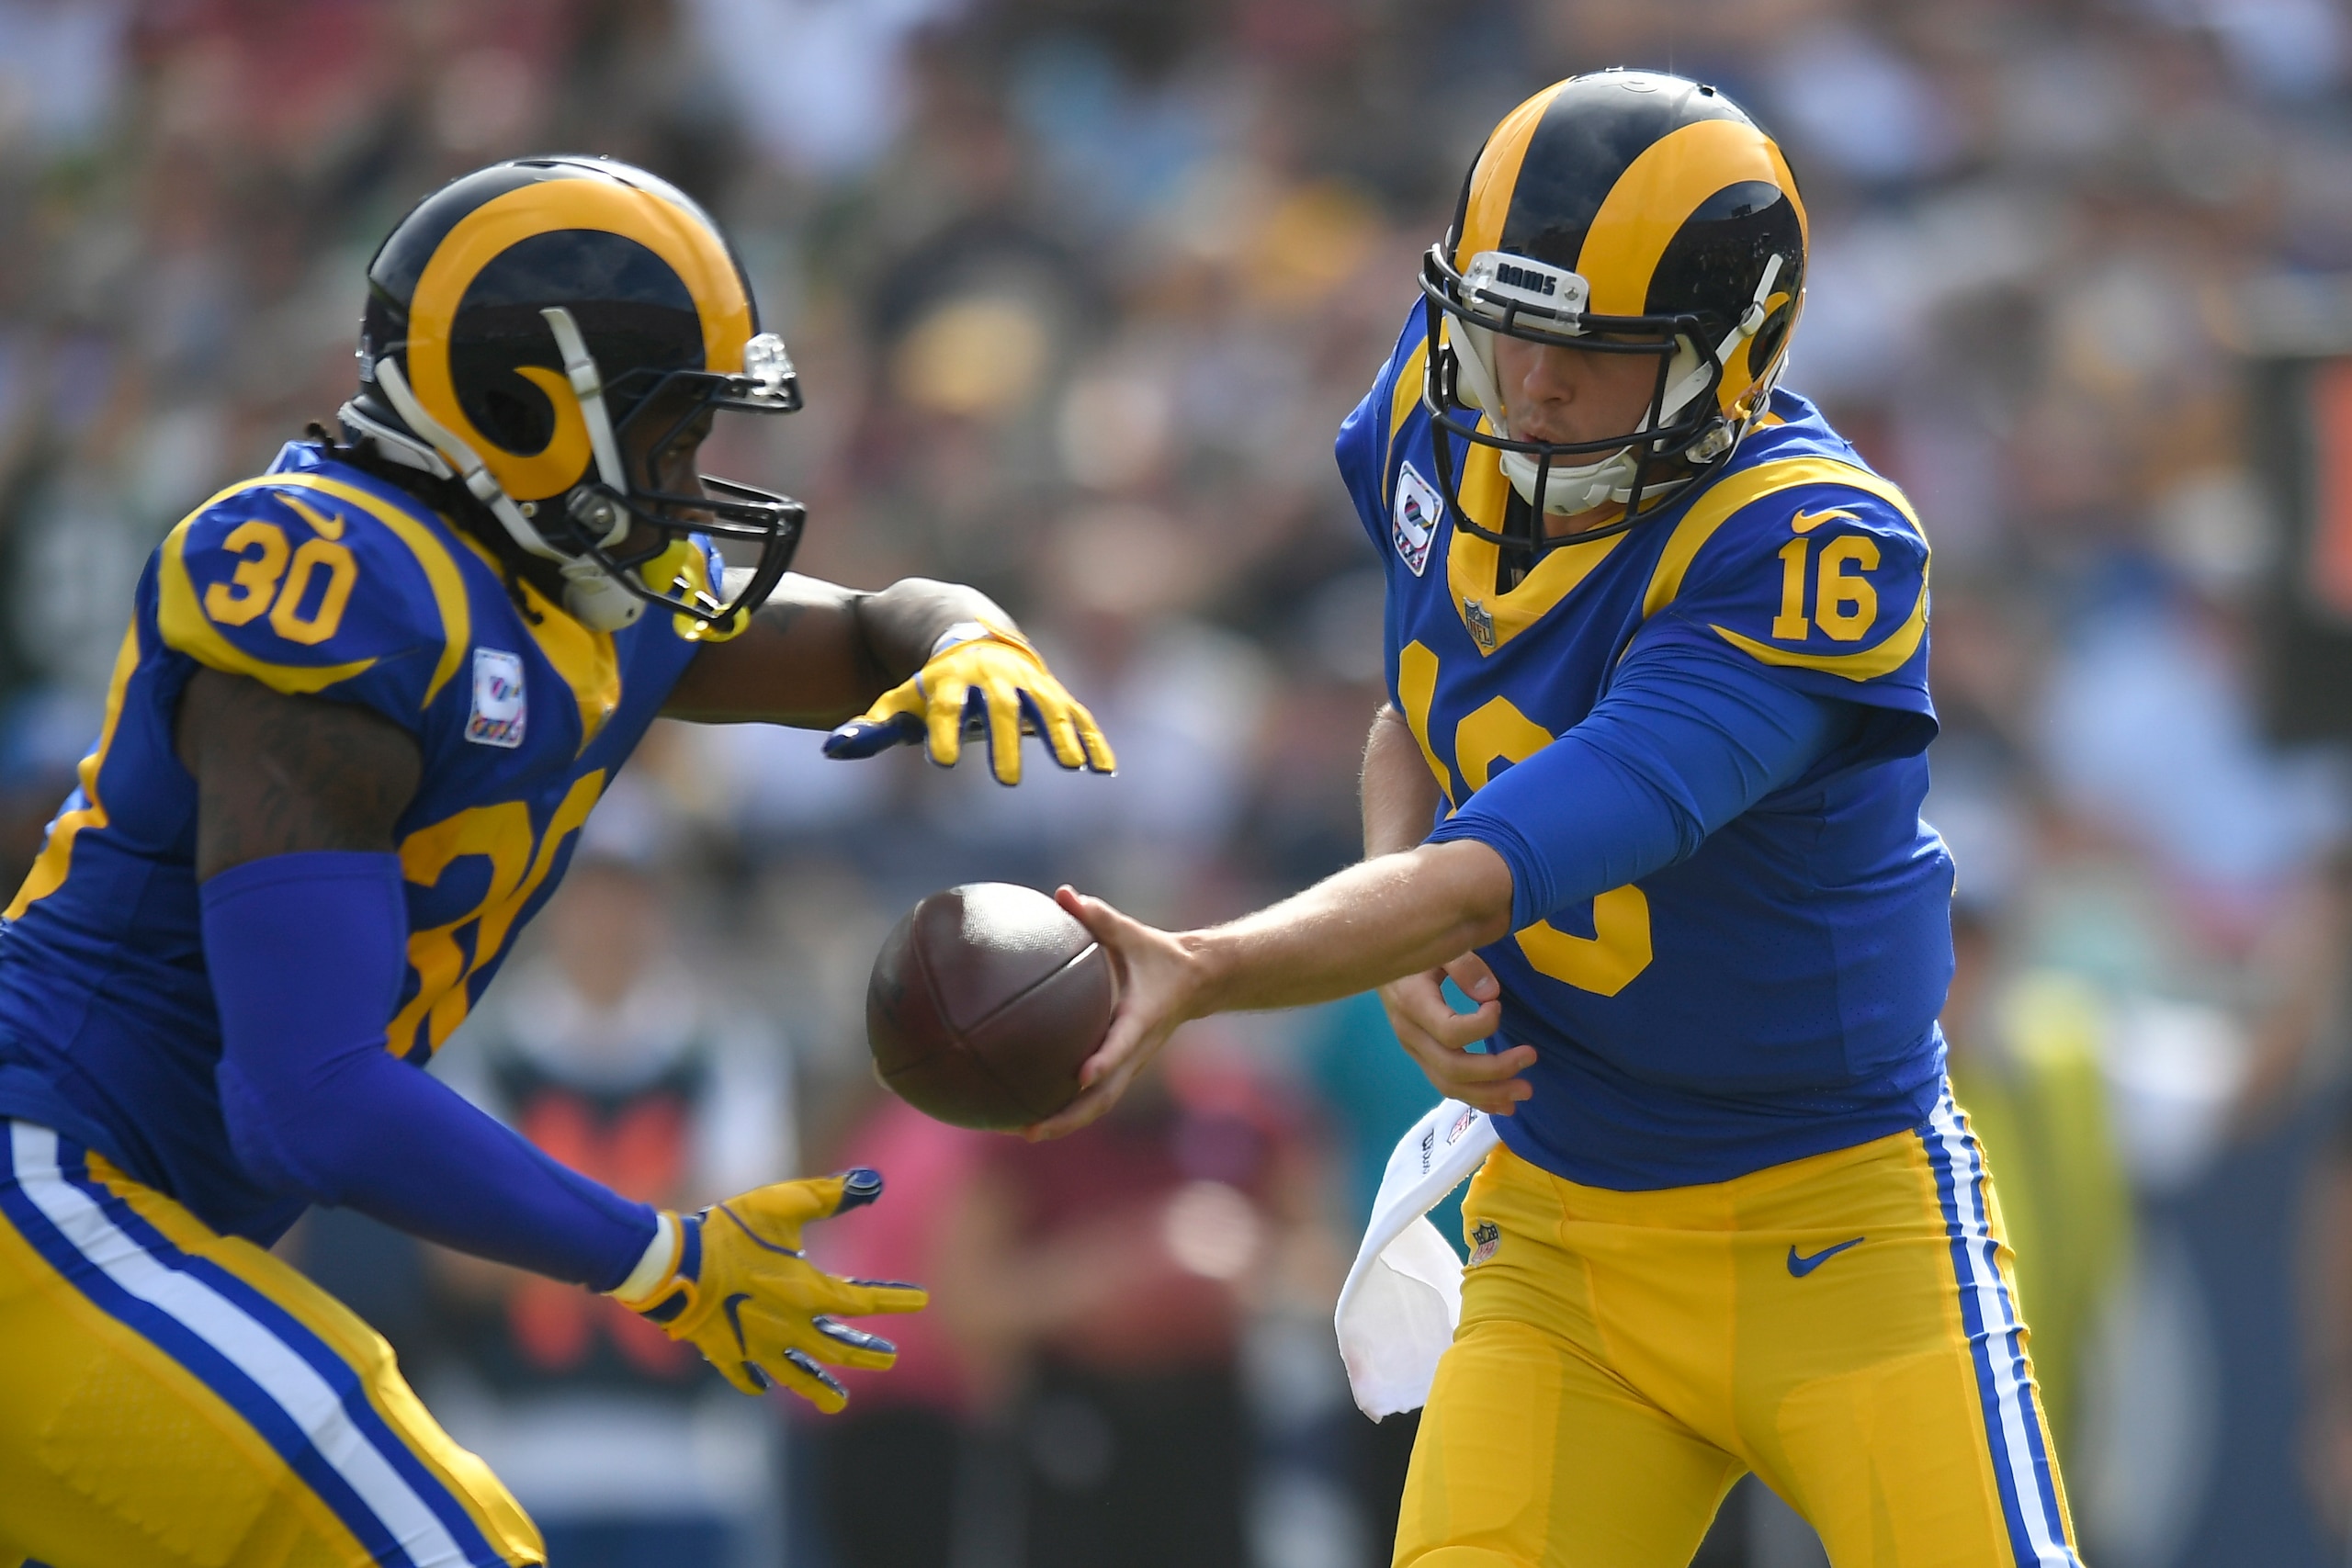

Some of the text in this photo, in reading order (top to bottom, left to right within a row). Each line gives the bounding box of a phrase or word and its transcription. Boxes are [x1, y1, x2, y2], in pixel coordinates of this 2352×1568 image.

[1496, 263, 1556, 296] RAMS
[1397, 473, 1433, 548] C
[204, 520, 359, 646] 30
[1772, 535, 1881, 641] 16
